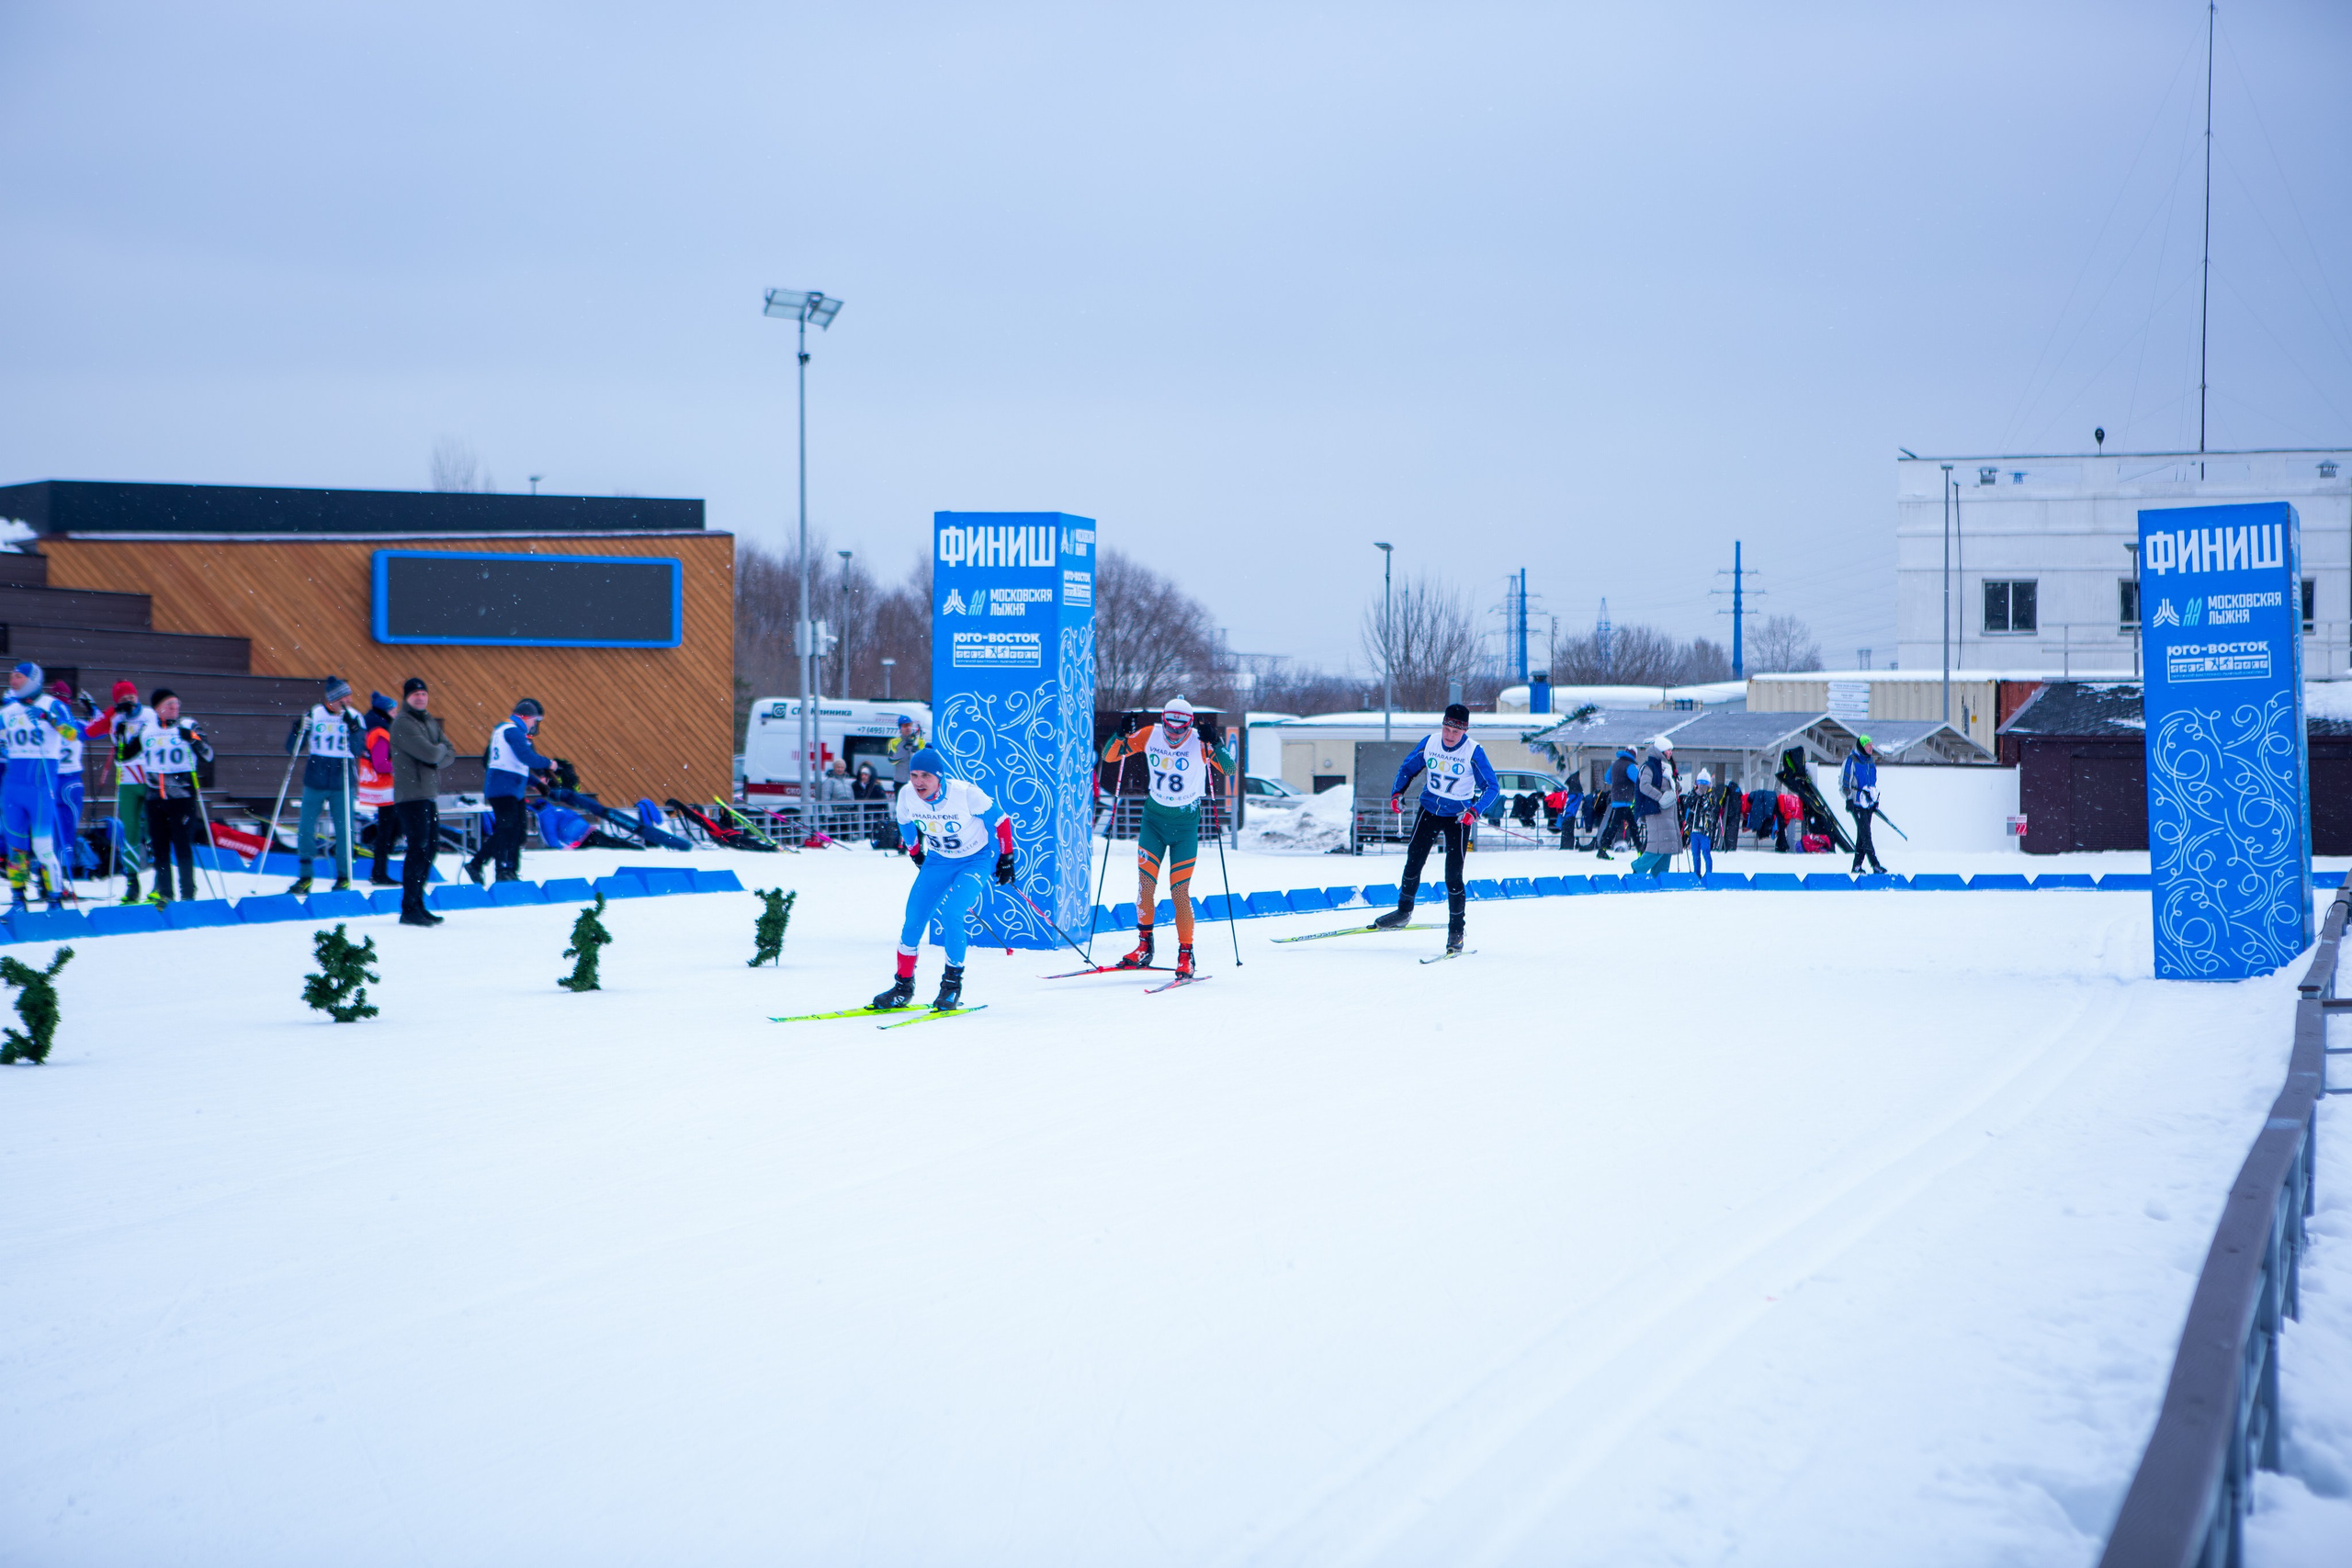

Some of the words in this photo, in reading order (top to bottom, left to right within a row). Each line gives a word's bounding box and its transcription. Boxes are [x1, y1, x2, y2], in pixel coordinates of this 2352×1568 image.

[940, 526, 1056, 567] ФИНИШ
[2146, 524, 2284, 576] ФИНИШ
[989, 589, 1053, 603] МОСКОВСКАЯ
[2208, 592, 2282, 609] МОСКОВСКАЯ
[989, 603, 1025, 616] ЛЫЖНЯ
[2208, 609, 2250, 626] ЛЫЖНЯ
[954, 633, 1041, 644] ЮГО-ВОСТОК
[2166, 640, 2269, 658] ЮГО-ВОСТОК
[866, 726, 885, 735] (495)
[145, 747, 184, 765] 110
[1149, 746, 1190, 757] VMARAFONE
[1429, 751, 1466, 763] VMARAFONE
[1154, 770, 1185, 793] 78
[1430, 772, 1460, 794] 57
